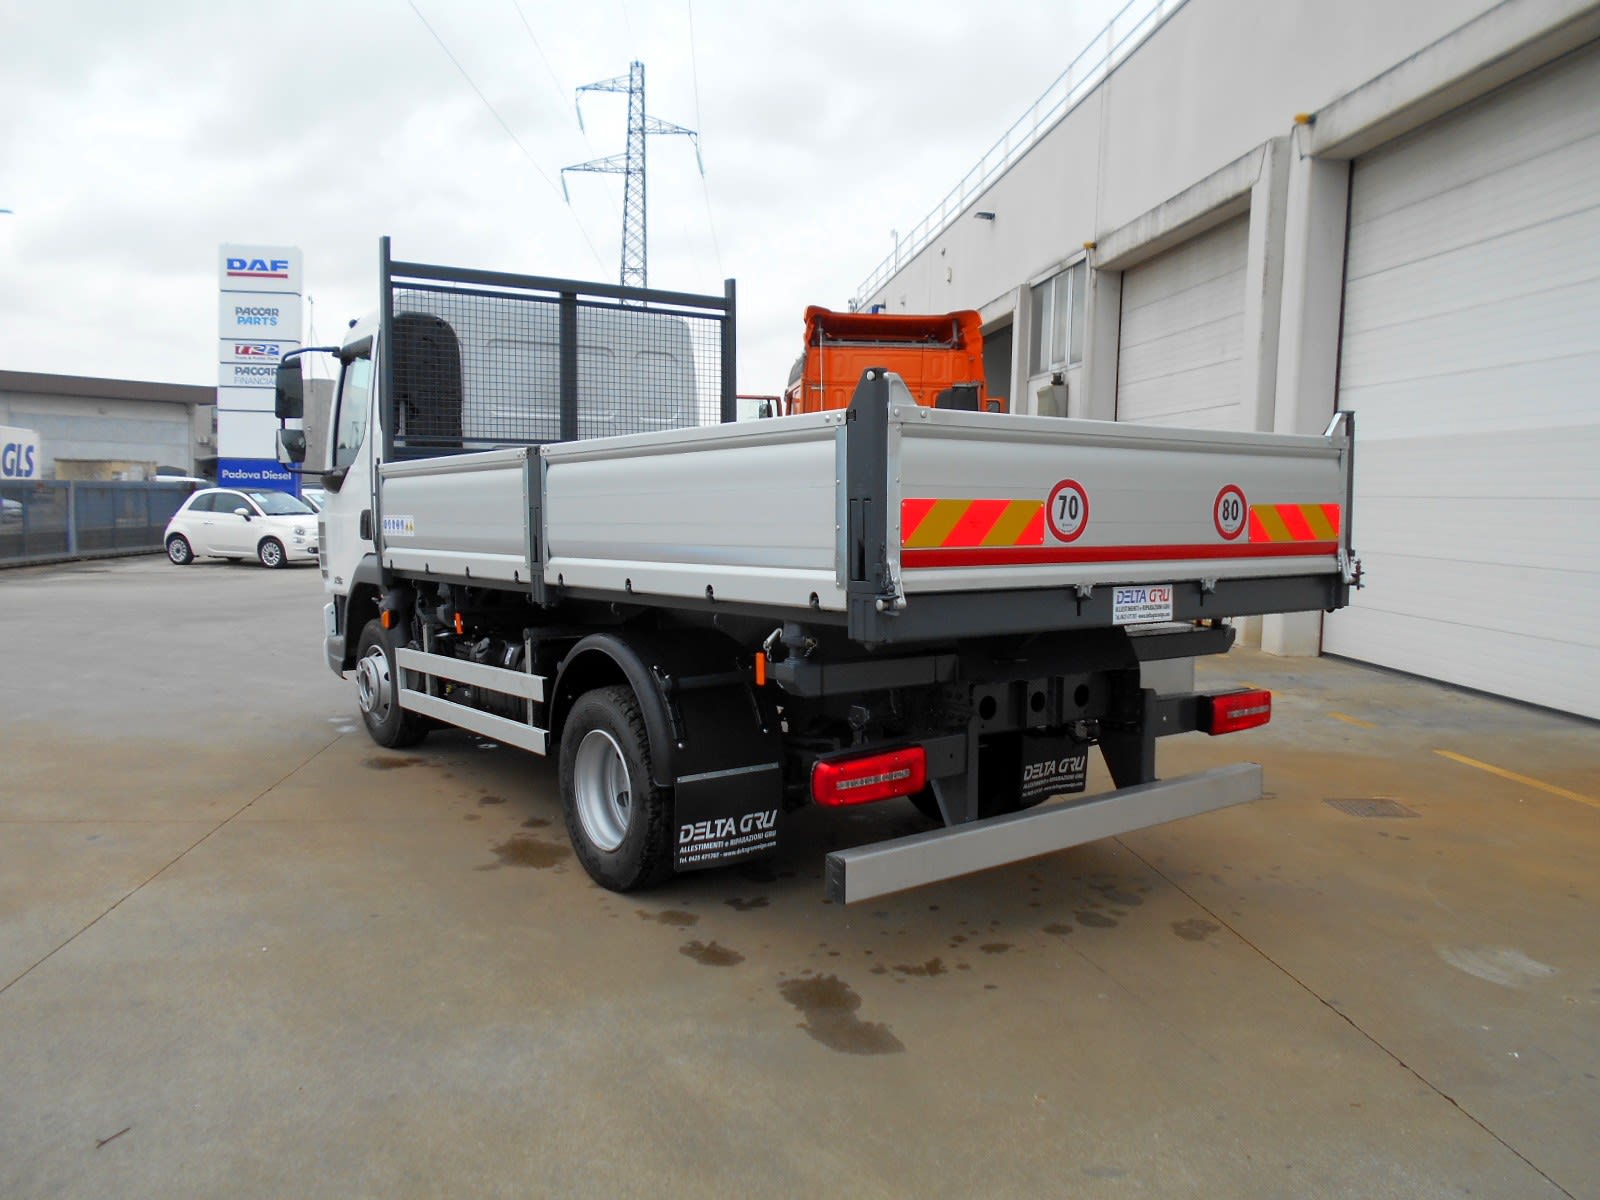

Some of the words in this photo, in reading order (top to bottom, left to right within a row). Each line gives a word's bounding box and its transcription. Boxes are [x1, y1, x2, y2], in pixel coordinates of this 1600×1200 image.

[226, 258, 288, 272] DAF
[235, 306, 279, 317] PACCAR
[236, 316, 278, 326] PARTS
[234, 366, 278, 376] PACCAR
[234, 377, 275, 385] FINANCIA
[2, 443, 34, 478] GLS
[222, 468, 260, 479] Padova
[261, 470, 292, 480] Diesel
[1058, 495, 1079, 520] 70
[1222, 499, 1239, 521] 80
[1116, 589, 1147, 604] DELTA
[1149, 588, 1170, 603] GRU
[1023, 759, 1056, 781] DELTA
[1058, 755, 1085, 773] GRU
[679, 816, 737, 844] DELTA
[739, 809, 778, 833] GRU
[679, 840, 724, 854] ALLESTIMENTI
